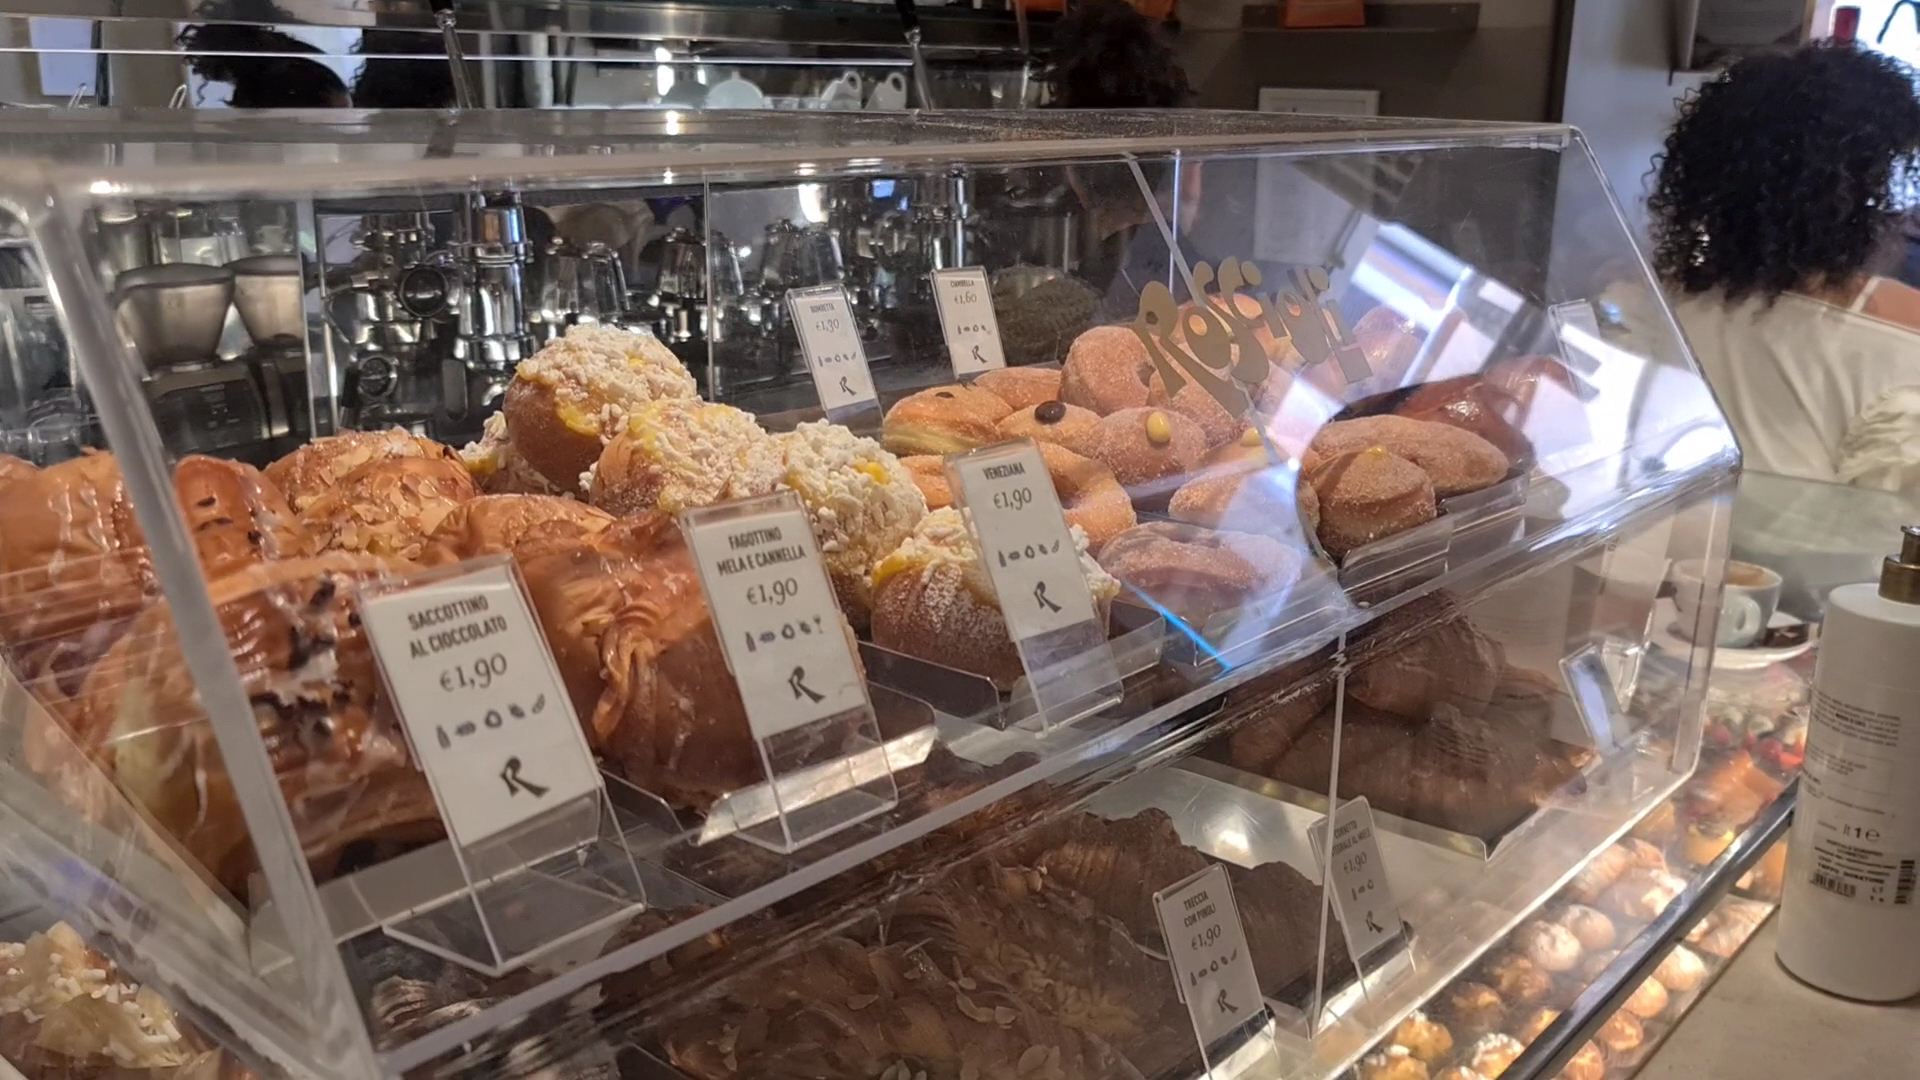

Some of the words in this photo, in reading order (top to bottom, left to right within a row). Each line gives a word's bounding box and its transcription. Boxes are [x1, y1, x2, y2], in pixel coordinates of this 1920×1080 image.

[954, 291, 977, 304] €1,60
[816, 318, 840, 334] €1,30
[972, 345, 988, 364] R
[839, 376, 857, 396] R
[982, 462, 1026, 480] VENEZIANA
[993, 487, 1032, 511] €1,90
[728, 526, 783, 551] FAGOTTINO
[716, 558, 747, 577] MELA
[748, 558, 756, 569] E
[755, 545, 807, 568] CANNELLA
[746, 577, 798, 606] €1,90
[1033, 581, 1062, 613] R
[407, 594, 489, 631] SACCOTTINO
[409, 638, 429, 660] AL
[429, 615, 508, 653] CIOCCOLATO
[439, 653, 508, 692] €1,90
[788, 665, 826, 704] R
[499, 756, 550, 799] R
[1343, 851, 1368, 875] €1,90
[1183, 890, 1209, 911] TRECCIA
[1184, 911, 1198, 928] CON
[1197, 903, 1217, 923] PINOLI
[1191, 924, 1222, 950] €1,90
[1217, 989, 1239, 1013] R
